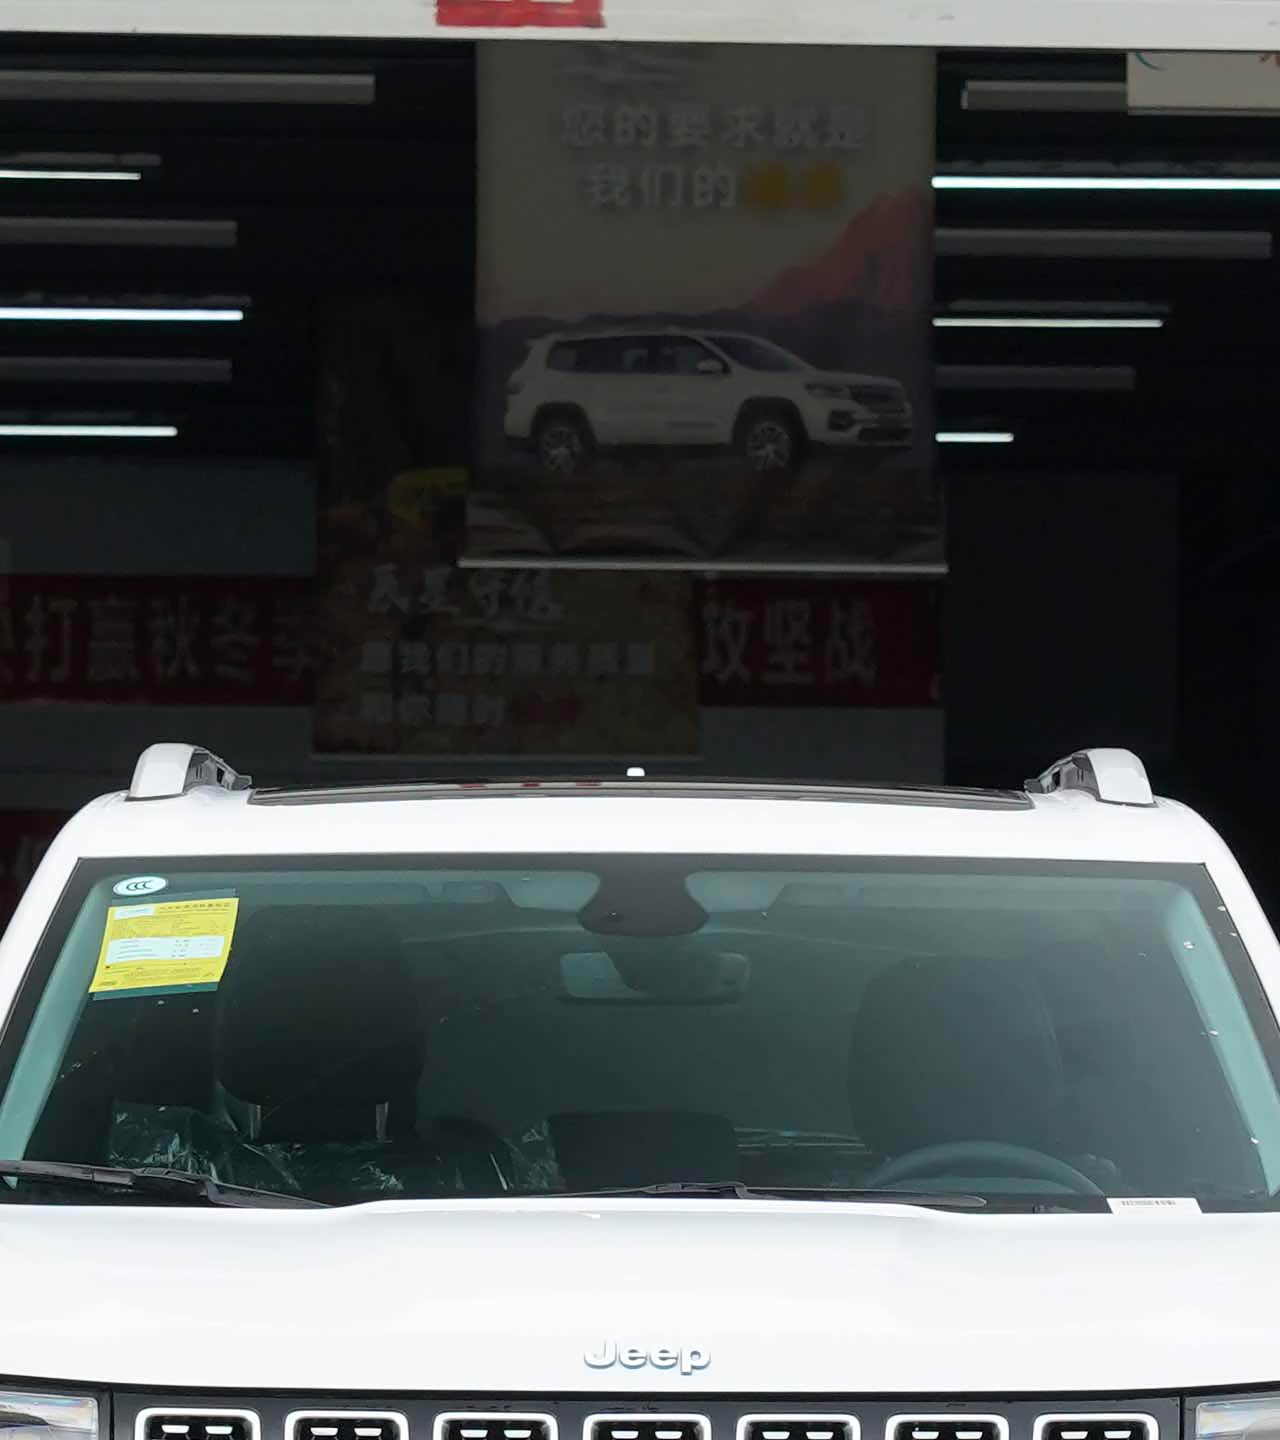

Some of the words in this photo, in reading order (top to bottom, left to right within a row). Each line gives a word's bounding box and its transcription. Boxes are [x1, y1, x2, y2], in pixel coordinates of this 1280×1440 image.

[587, 161, 845, 210] 我们的
[583, 1339, 712, 1376] Jeep
